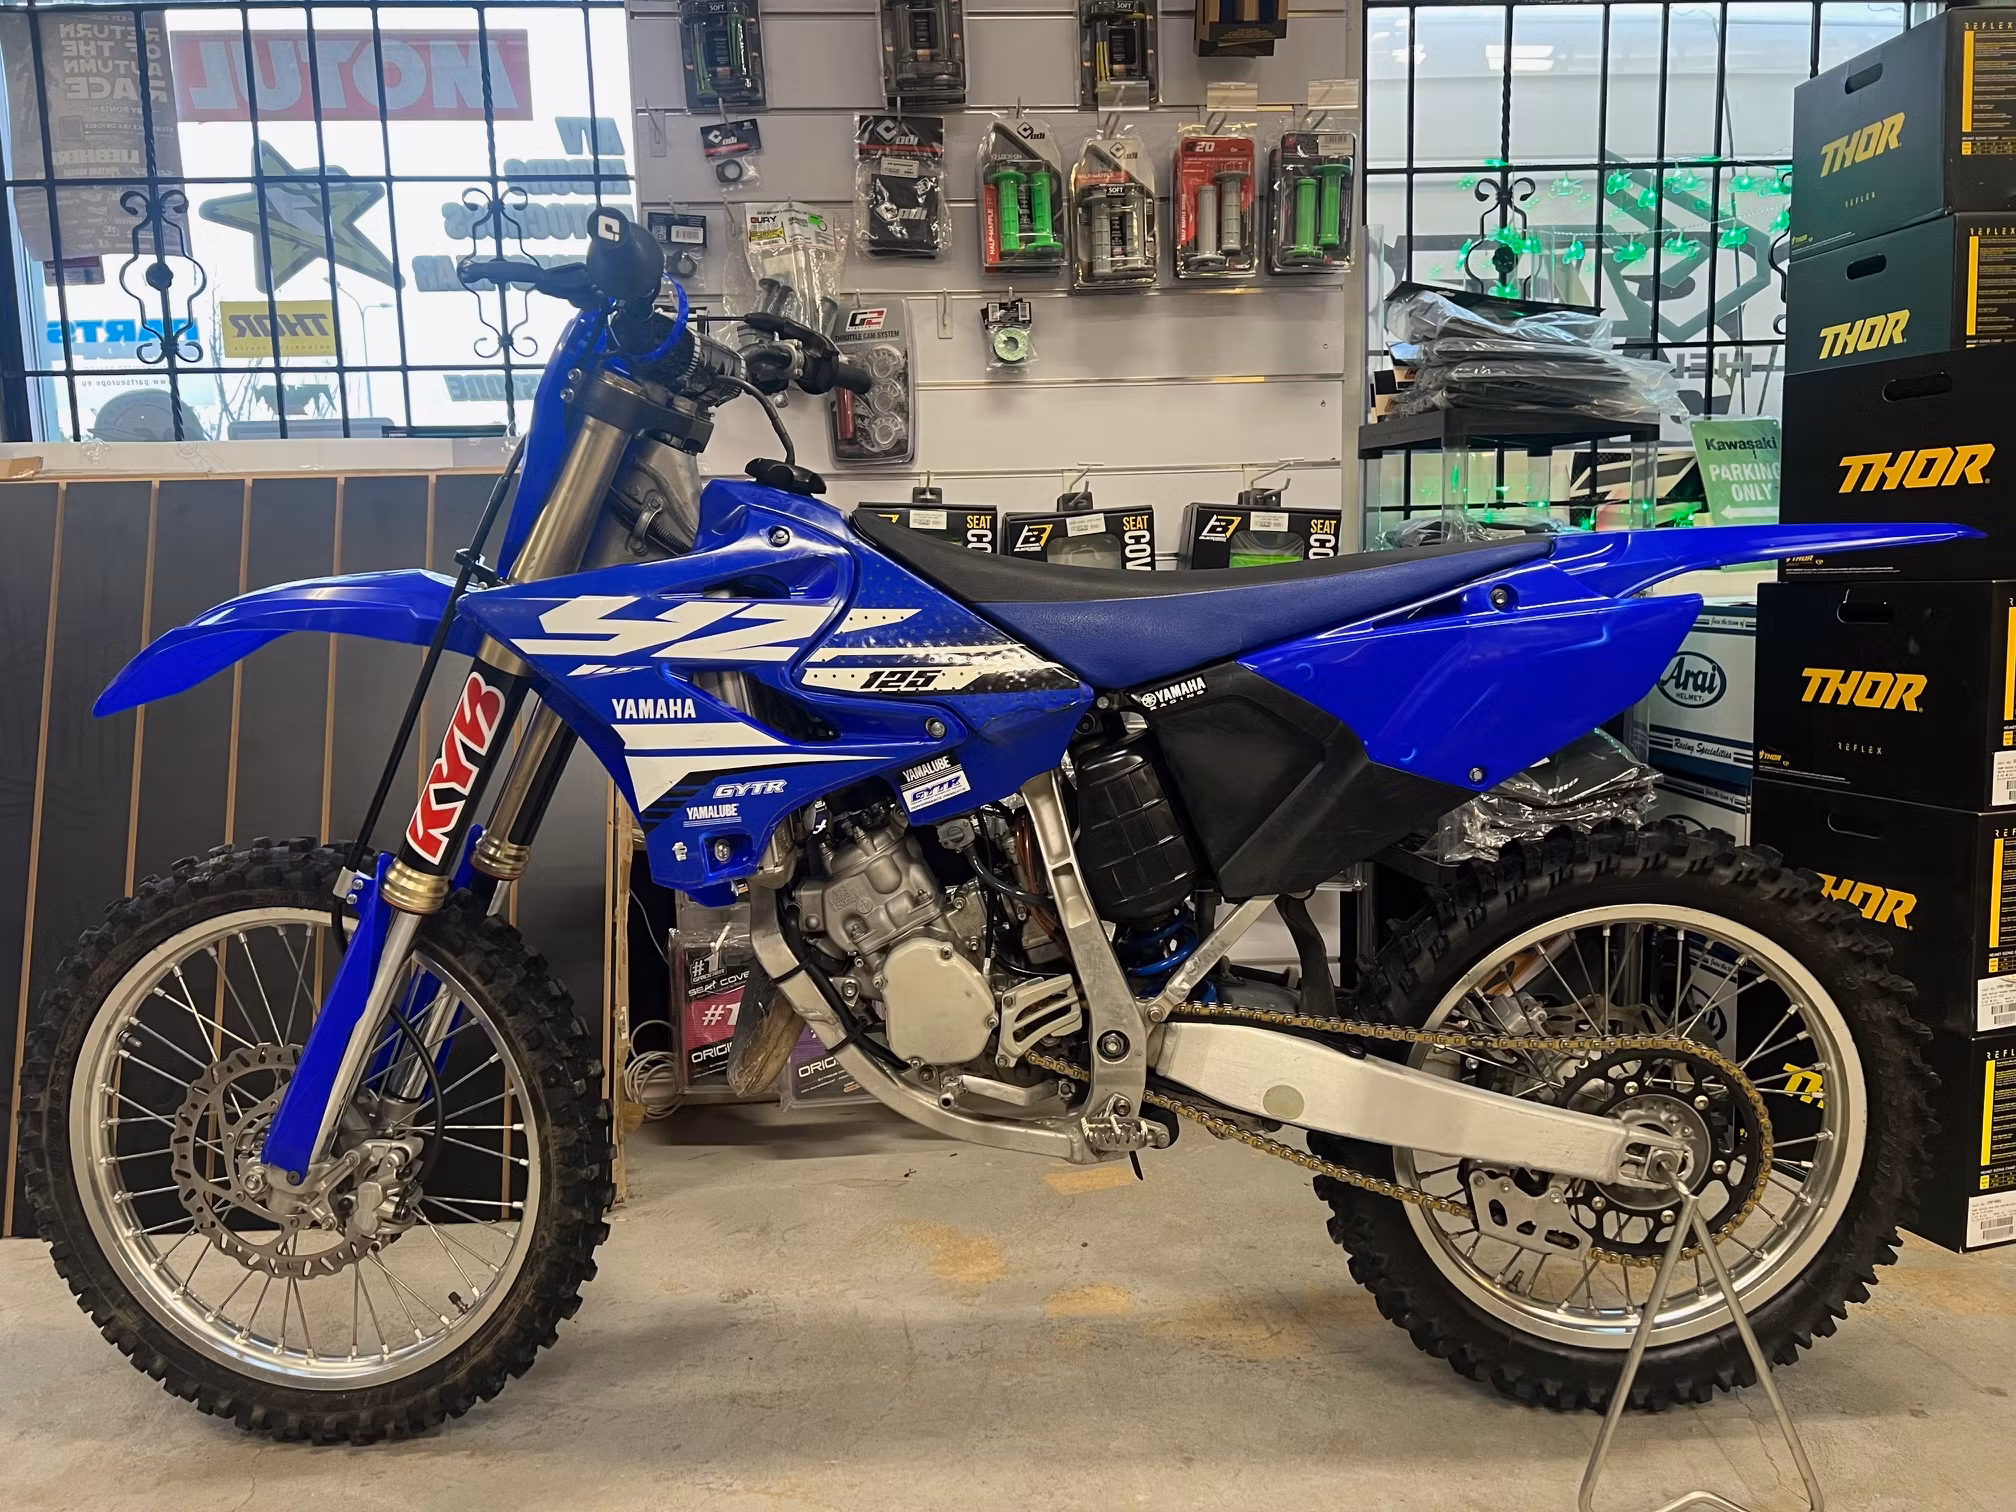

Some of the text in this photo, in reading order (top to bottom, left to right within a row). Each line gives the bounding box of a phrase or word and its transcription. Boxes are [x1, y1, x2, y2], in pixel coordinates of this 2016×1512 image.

[1116, 2, 1132, 10] SOFT
[1964, 21, 2013, 30] REFLEX
[1820, 111, 1906, 178] THOR
[1108, 186, 1124, 194] SOFT
[750, 215, 777, 224] OURY
[1969, 227, 2016, 236] REFLEX
[834, 330, 900, 341] THROTTLE CAM SYSTEM
[1818, 309, 1912, 360] THOR
[1704, 436, 1778, 451] Kawasaki
[1838, 443, 1996, 494] THOR
[1731, 482, 1773, 502] ONLY
[966, 515, 992, 529] SEAT
[1122, 515, 1149, 531] SEAT
[1310, 519, 1337, 534] SEAT
[860, 669, 945, 690] 125
[1659, 657, 1719, 695] Arai
[1155, 676, 1207, 703] YAMAHA
[1802, 667, 1928, 712] THOR
[611, 698, 697, 719] YAMAHA
[1673, 738, 1695, 755] Racing
[1837, 741, 1882, 755] REFLEX
[406, 671, 505, 866] KYB
[902, 755, 952, 783] YAMALUBE
[712, 779, 788, 799] GYTR
[911, 775, 961, 802] GYTR
[686, 803, 740, 820] YAMALUBE
[1815, 872, 1918, 930] HOR
[691, 951, 720, 977] #1
[701, 1001, 742, 1026] #1
